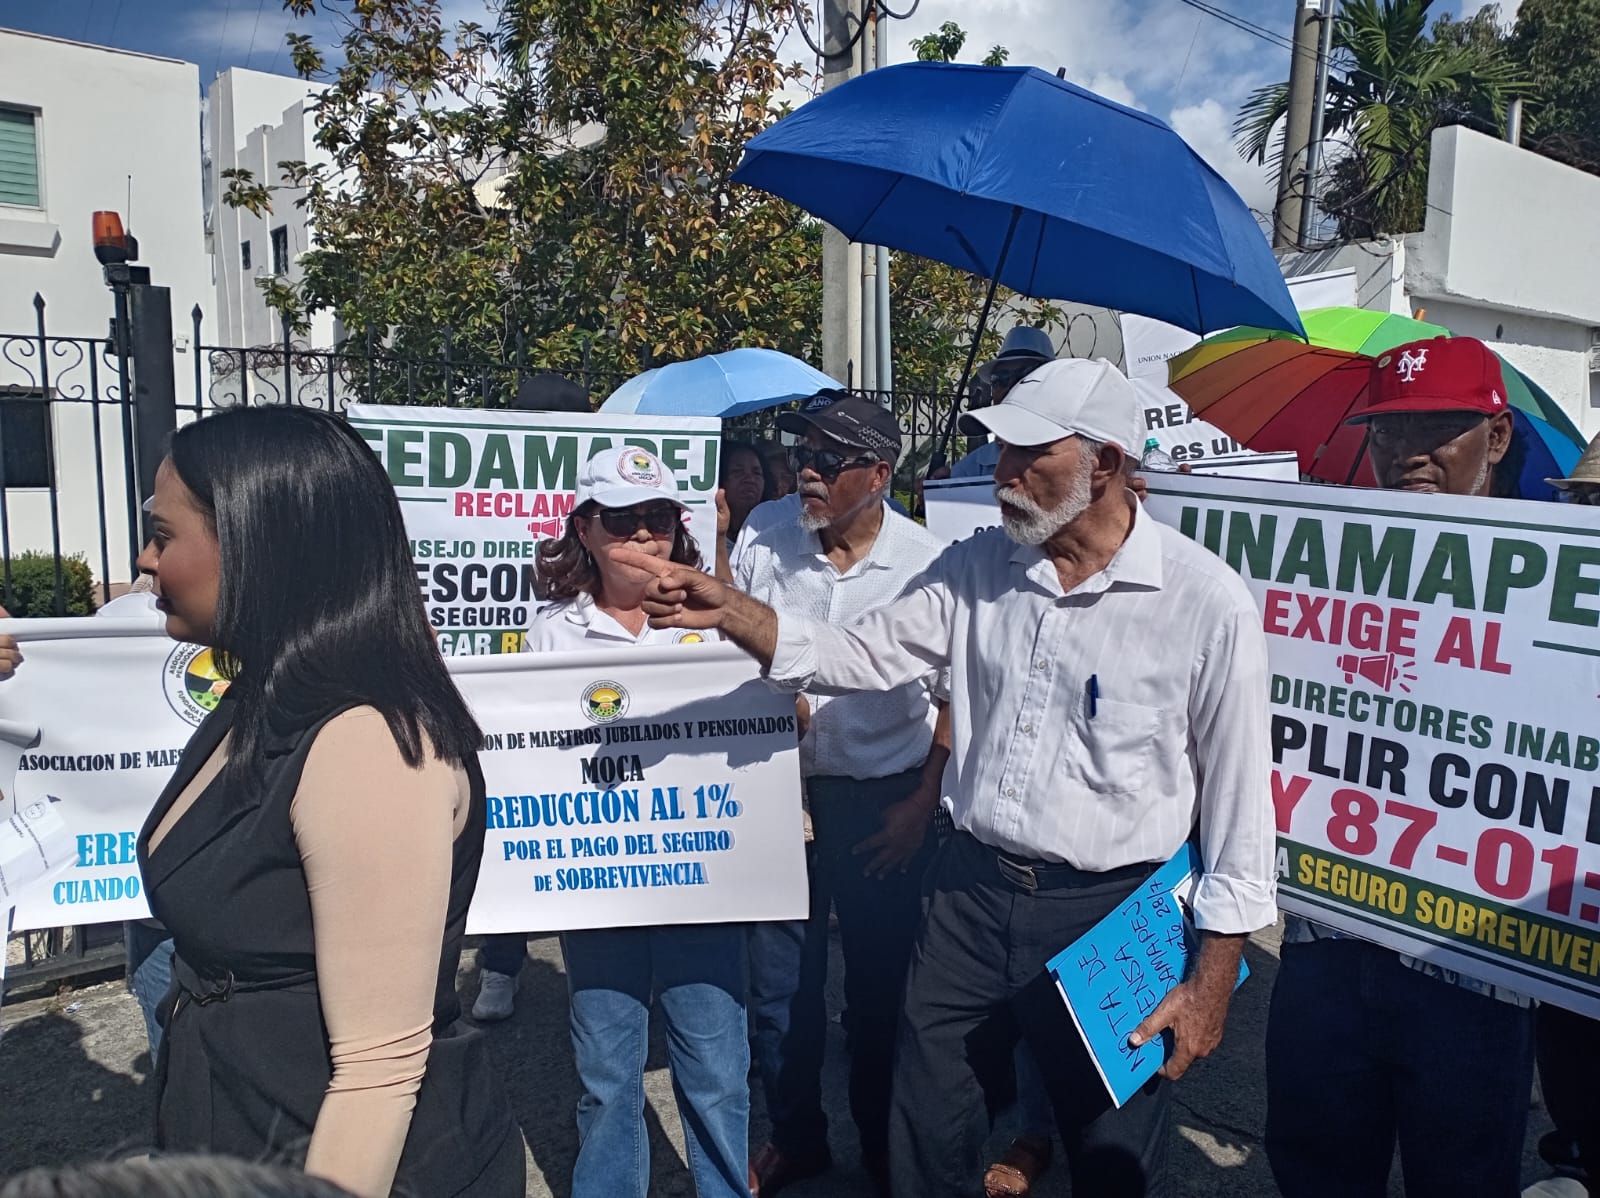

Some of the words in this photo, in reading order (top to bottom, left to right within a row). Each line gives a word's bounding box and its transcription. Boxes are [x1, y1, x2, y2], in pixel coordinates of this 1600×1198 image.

[1138, 353, 1162, 363] UNION
[1171, 441, 1205, 461] es
[430, 606, 528, 627] SEGURO
[1263, 589, 1420, 658] EXIGE
[1434, 616, 1512, 675] AL
[1270, 673, 1494, 749] DIRECTORES
[507, 732, 526, 750] DE
[529, 727, 601, 748] MAESTROS
[605, 722, 681, 746] JUBILADOS
[684, 721, 693, 739] Y
[698, 715, 795, 738] PENSIONADOS
[18, 753, 115, 772] ASOCIACION
[120, 751, 142, 770] DE
[580, 754, 645, 785] MOCA
[1271, 714, 1410, 796] PLIR
[1428, 752, 1571, 836] CON
[486, 783, 641, 830] REDUCCIÓN
[650, 786, 686, 821] AL
[693, 782, 739, 819] 1%
[1270, 769, 1313, 834] Y
[502, 839, 542, 861] POR
[546, 838, 566, 860] EL
[570, 836, 620, 858] PAGO
[624, 833, 657, 856] DEL
[663, 829, 733, 854] SEGURO
[53, 875, 140, 906] CUANDO
[534, 874, 552, 892] DE
[556, 861, 706, 892] SOBREVIVENCIA
[1297, 853, 1408, 915] SEGURO
[1078, 943, 1107, 988] DE
